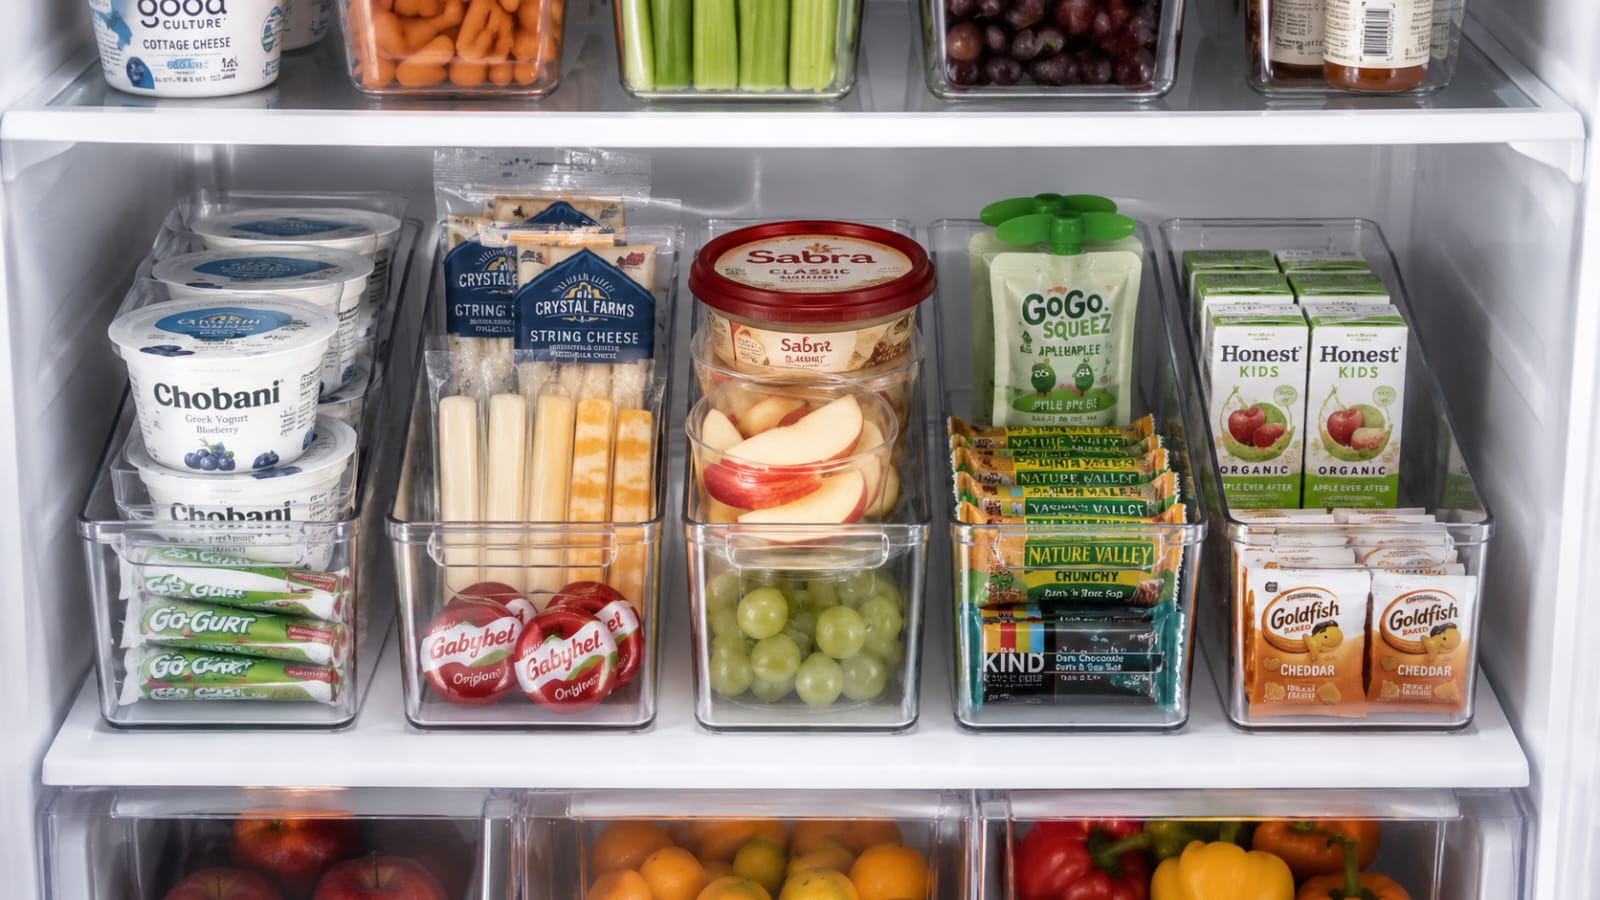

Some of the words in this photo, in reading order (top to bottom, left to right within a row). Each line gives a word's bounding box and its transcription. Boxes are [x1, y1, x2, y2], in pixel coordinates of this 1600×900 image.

[163, 18, 222, 30] CULTURE
[143, 39, 190, 50] COTTAGE
[193, 37, 231, 50] CHEESE
[746, 250, 877, 264] Sabra
[535, 300, 589, 316] CRYSTAL
[593, 300, 635, 317] FARMS
[1043, 313, 1112, 341] SQUEEZ
[530, 330, 581, 342] STRING
[587, 331, 639, 344] CHEESE
[1221, 346, 1299, 362] Honest
[1320, 346, 1399, 363] Honest
[1239, 366, 1279, 377] KIDS
[1339, 366, 1378, 378] KIDS
[153, 381, 280, 410] Chobani
[216, 414, 248, 426] Yogurt
[196, 425, 239, 435] Blueberry
[1220, 465, 1289, 475] ORGANIC
[1318, 466, 1387, 475] ORGANIC
[1028, 546, 1091, 566] NATURE
[1095, 546, 1152, 566] VALLEY
[1055, 571, 1119, 582] CRUNCHY
[1271, 600, 1340, 630] Goldfish
[1390, 602, 1459, 632] Goldfish
[983, 653, 1045, 673] KIND
[1281, 664, 1335, 677] CHEDDAR
[1398, 664, 1453, 677] CHEDDAR
